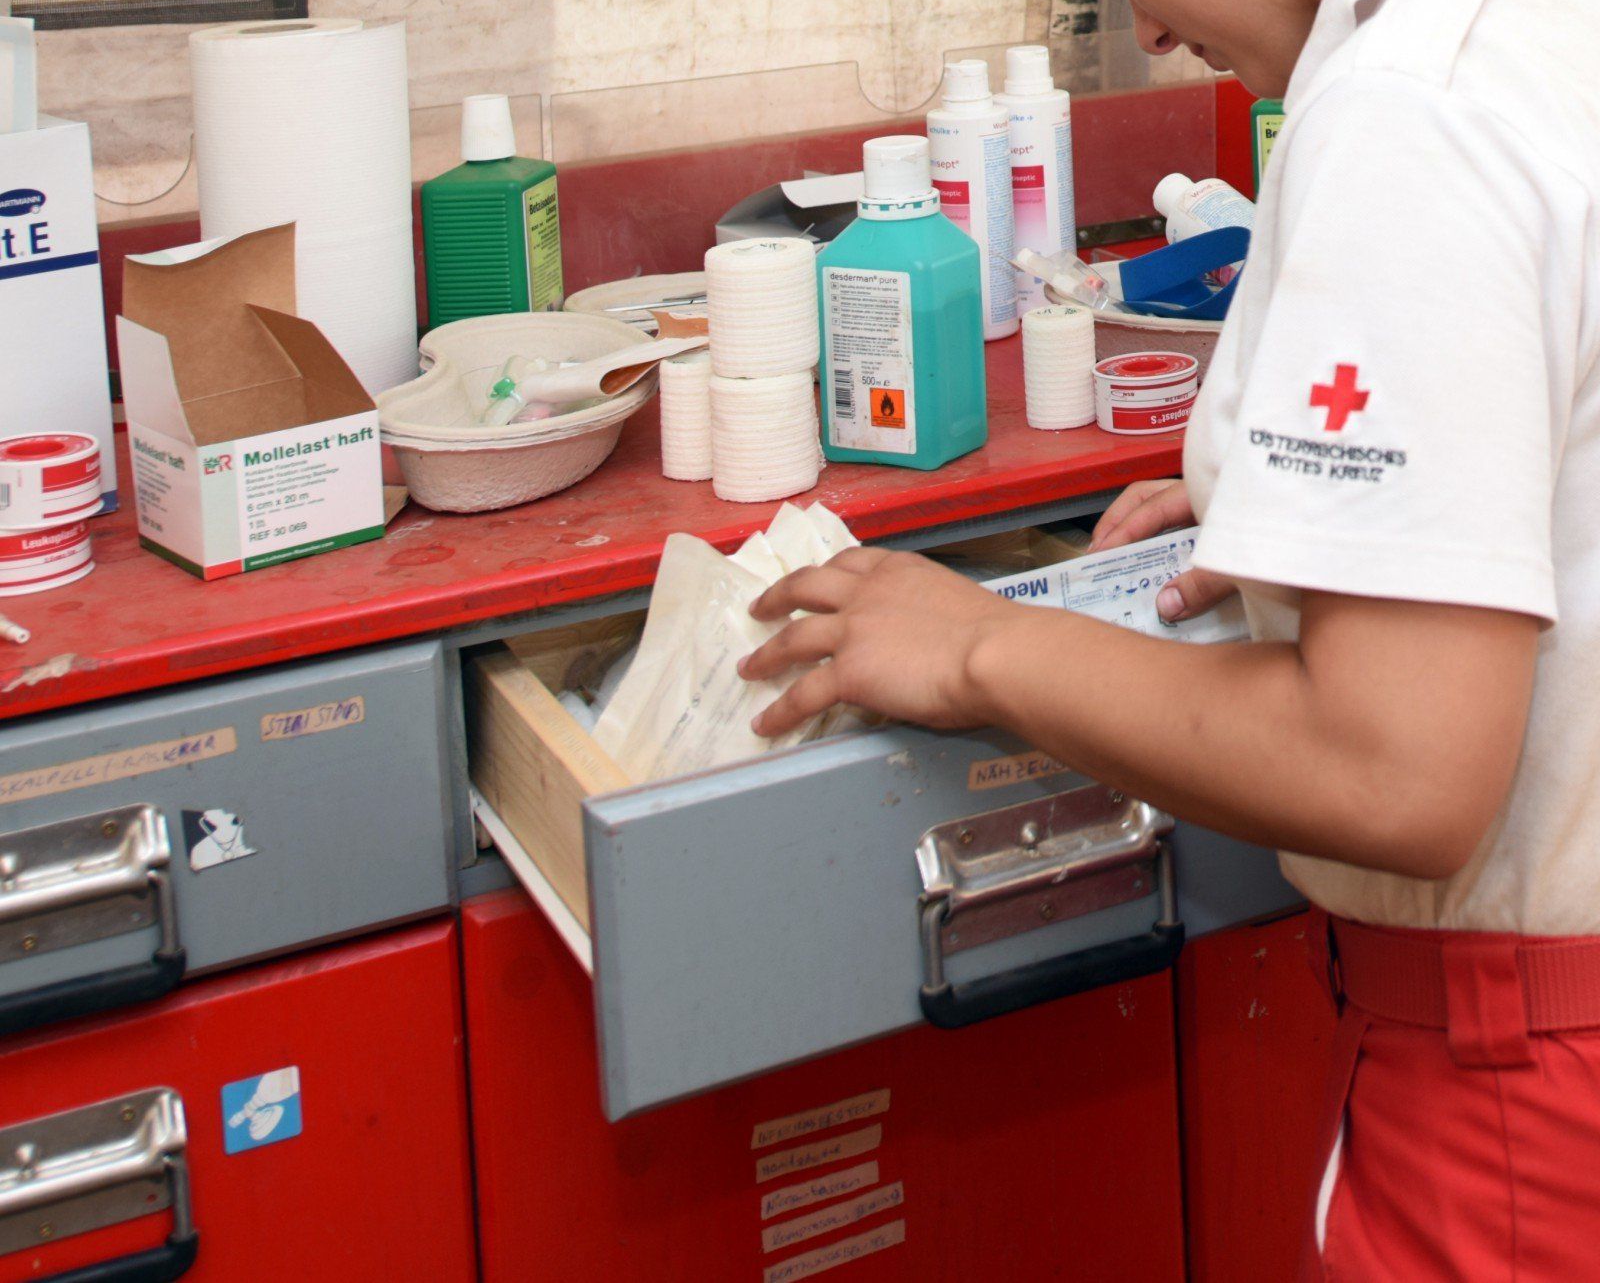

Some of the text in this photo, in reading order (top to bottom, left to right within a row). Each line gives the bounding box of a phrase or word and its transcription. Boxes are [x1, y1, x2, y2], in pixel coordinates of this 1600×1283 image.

[1265, 128, 1278, 139] Be
[0, 195, 41, 208] ARTMANN
[29, 221, 51, 254] E
[879, 276, 898, 285] pure
[1150, 415, 1157, 425] S
[337, 426, 375, 447] haft
[1267, 453, 1322, 475] ROTES
[284, 493, 298, 505] 20
[249, 529, 271, 543] REF
[998, 577, 1048, 599] Med
